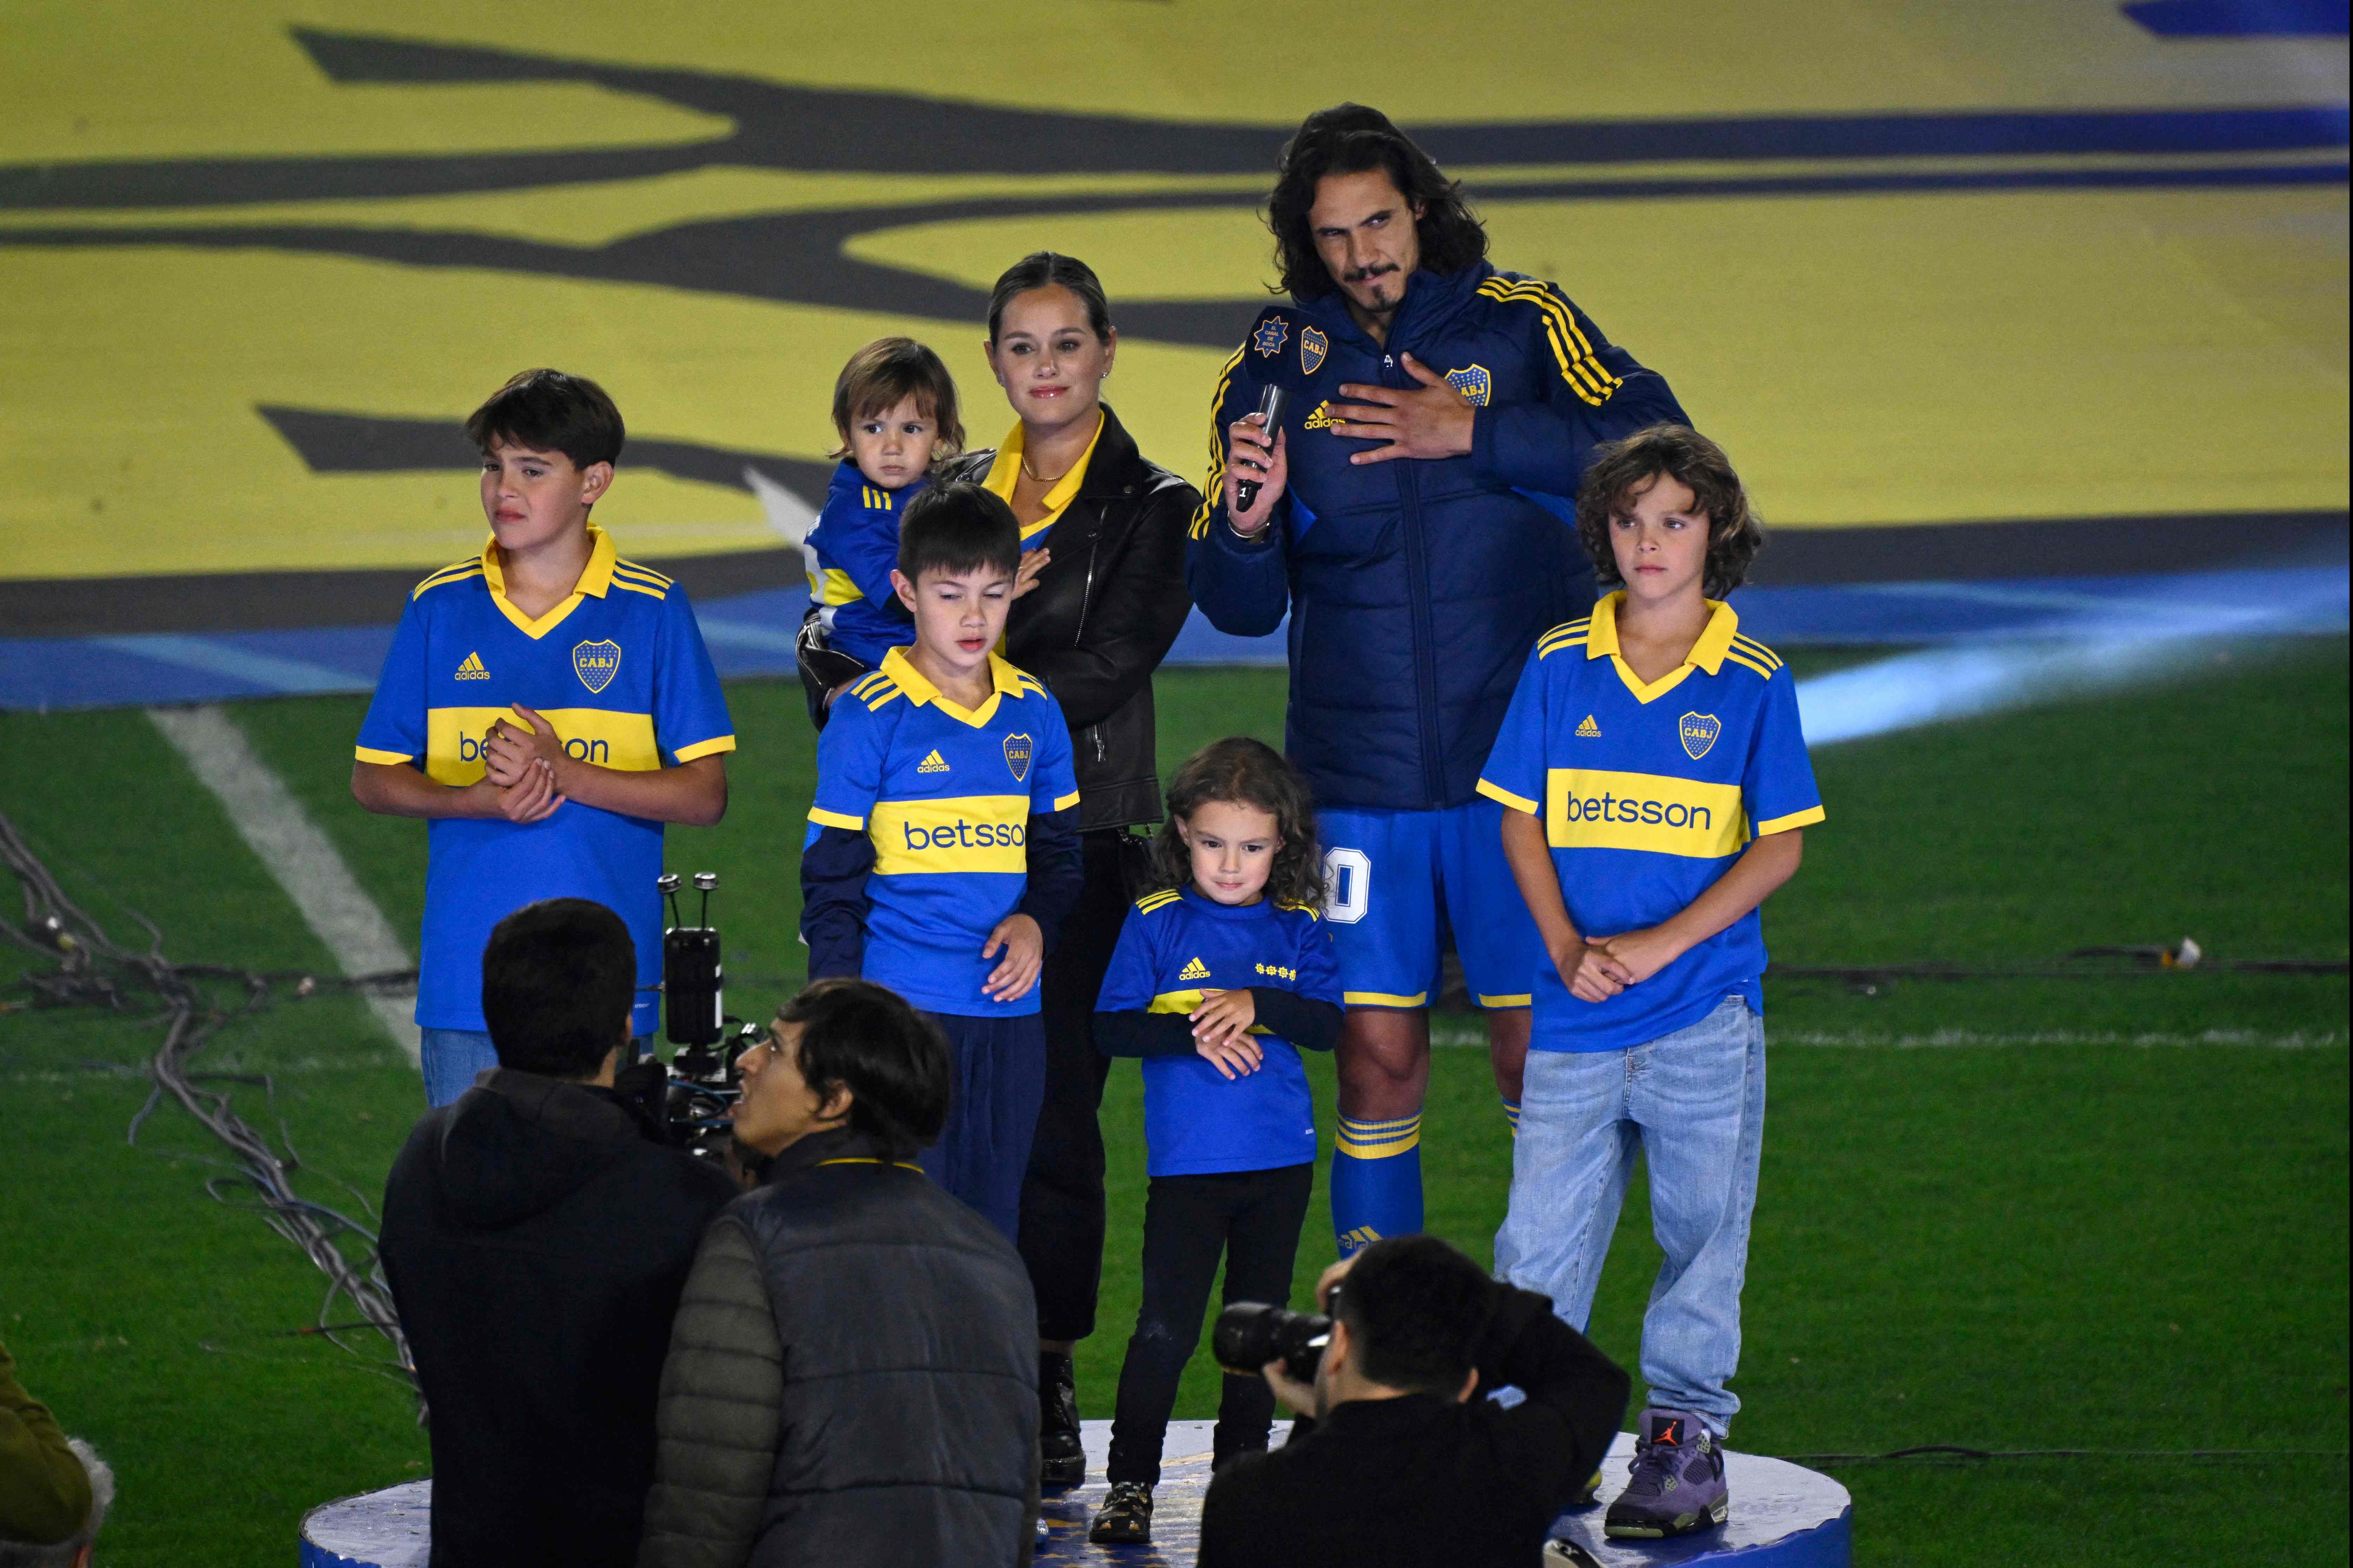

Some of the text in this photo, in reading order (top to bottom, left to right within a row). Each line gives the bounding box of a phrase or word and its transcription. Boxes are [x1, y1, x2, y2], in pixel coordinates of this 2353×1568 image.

[1304, 340, 1324, 356] CABJ
[1461, 383, 1485, 397] ABJ
[1239, 487, 1247, 497] 1
[579, 657, 614, 668] CABJ
[454, 670, 490, 680] adidas
[1575, 729, 1602, 737] adidas
[1684, 727, 1713, 739] CABJ
[1008, 750, 1029, 759] CABJ
[917, 764, 950, 773] adidas
[1567, 791, 1711, 830] betsson
[904, 819, 1026, 850] betsso
[1179, 970, 1211, 981] adidas
